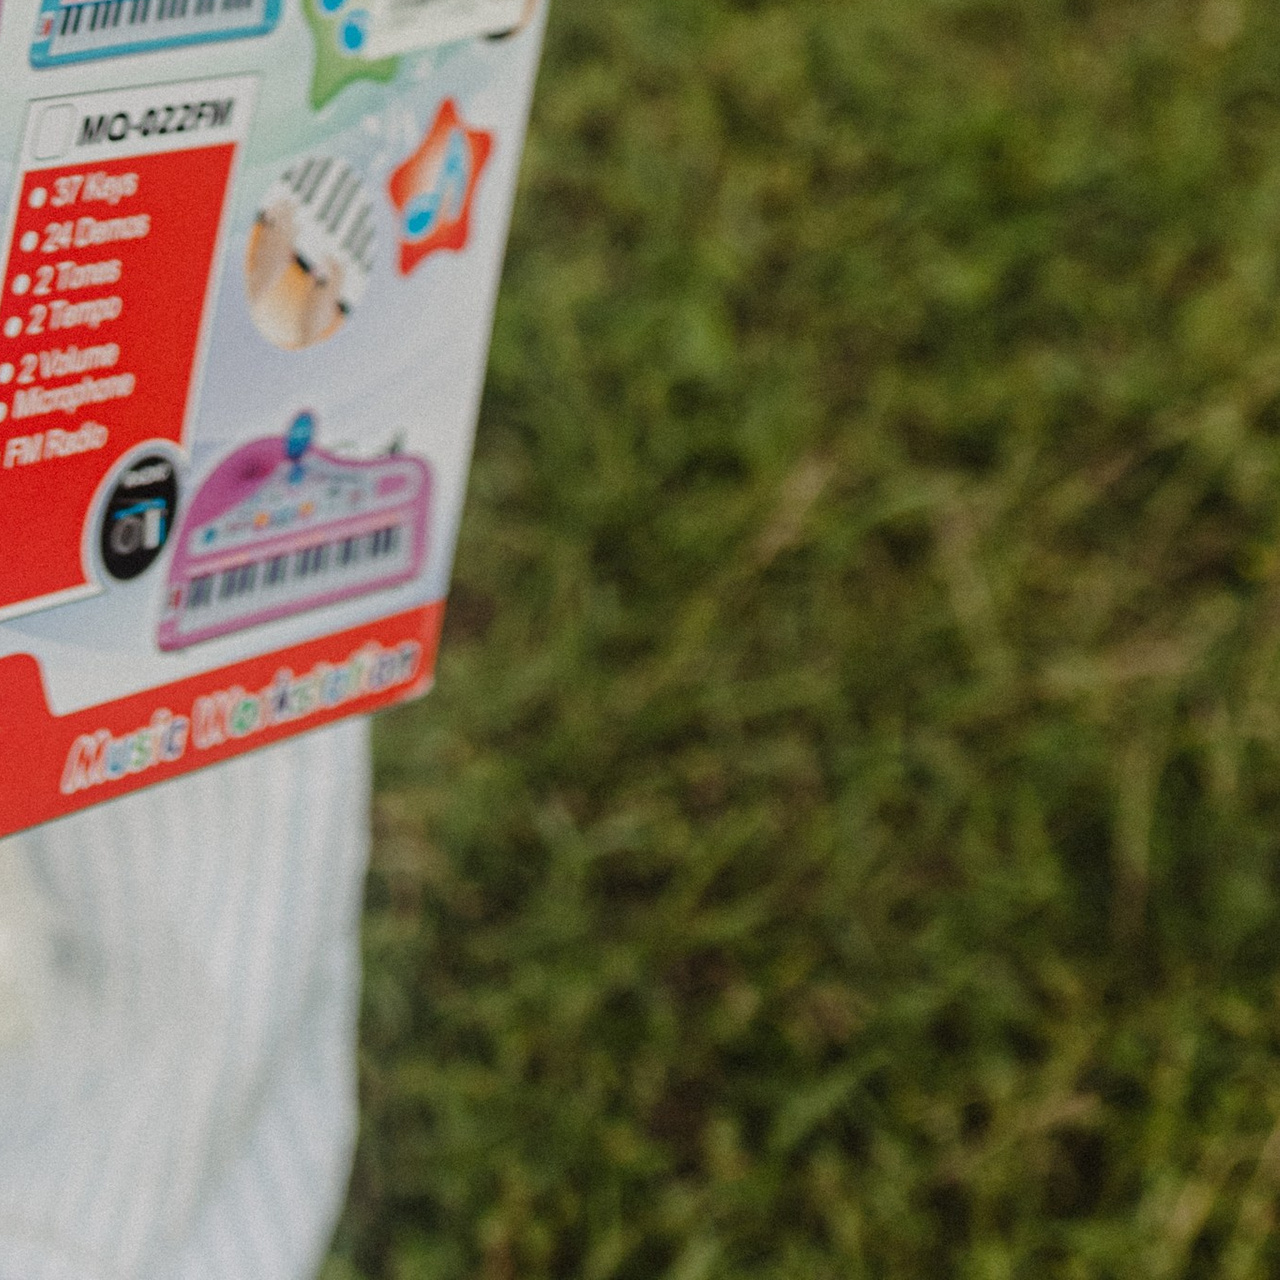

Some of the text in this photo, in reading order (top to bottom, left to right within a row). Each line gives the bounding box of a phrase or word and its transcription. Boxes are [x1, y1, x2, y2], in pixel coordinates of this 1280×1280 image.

[32, 265, 55, 296] 2
[25, 304, 48, 335] 2
[17, 353, 38, 384] 2
